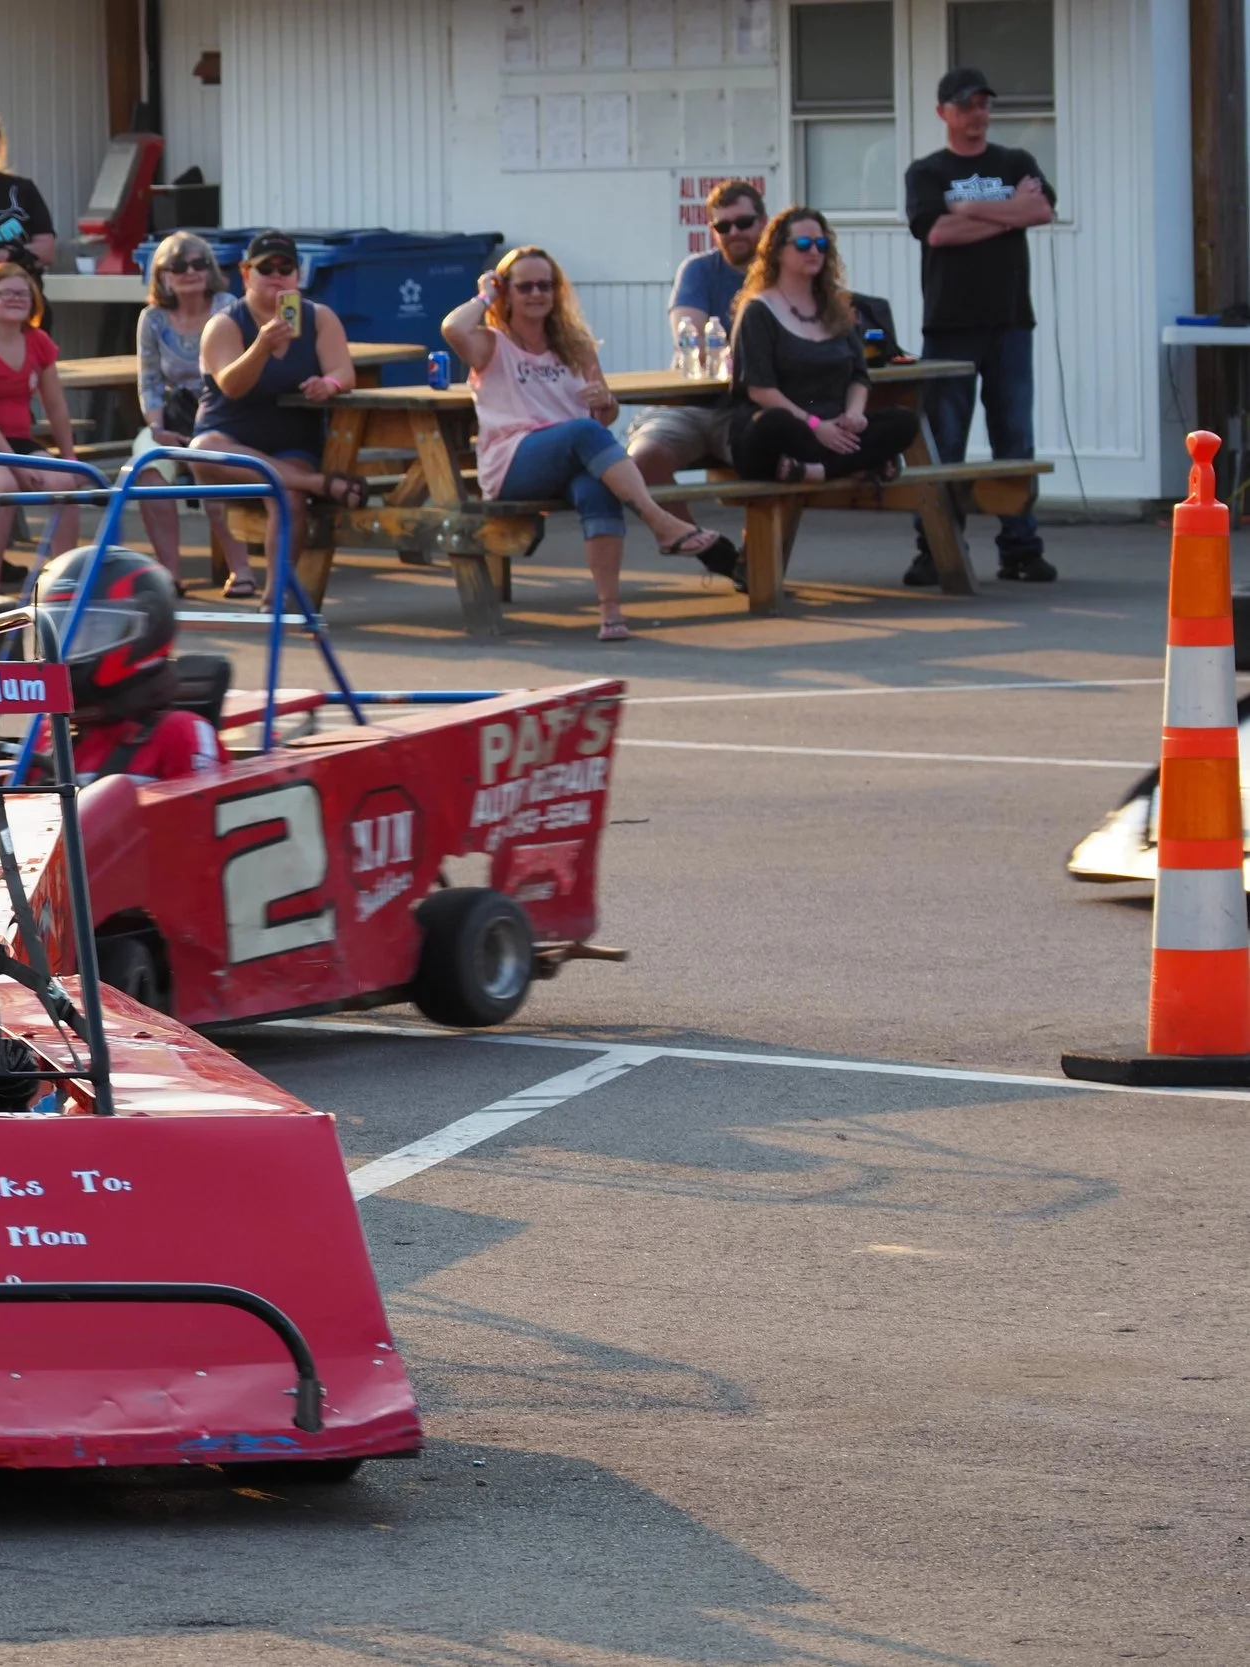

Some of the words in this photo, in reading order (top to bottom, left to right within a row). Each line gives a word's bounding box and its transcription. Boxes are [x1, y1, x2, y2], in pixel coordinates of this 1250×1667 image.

[680, 177, 694, 198] ALL
[470, 778, 527, 829] AUT
[215, 778, 337, 967] 2
[71, 1169, 133, 1193] To:
[6, 1225, 88, 1247] Mom
